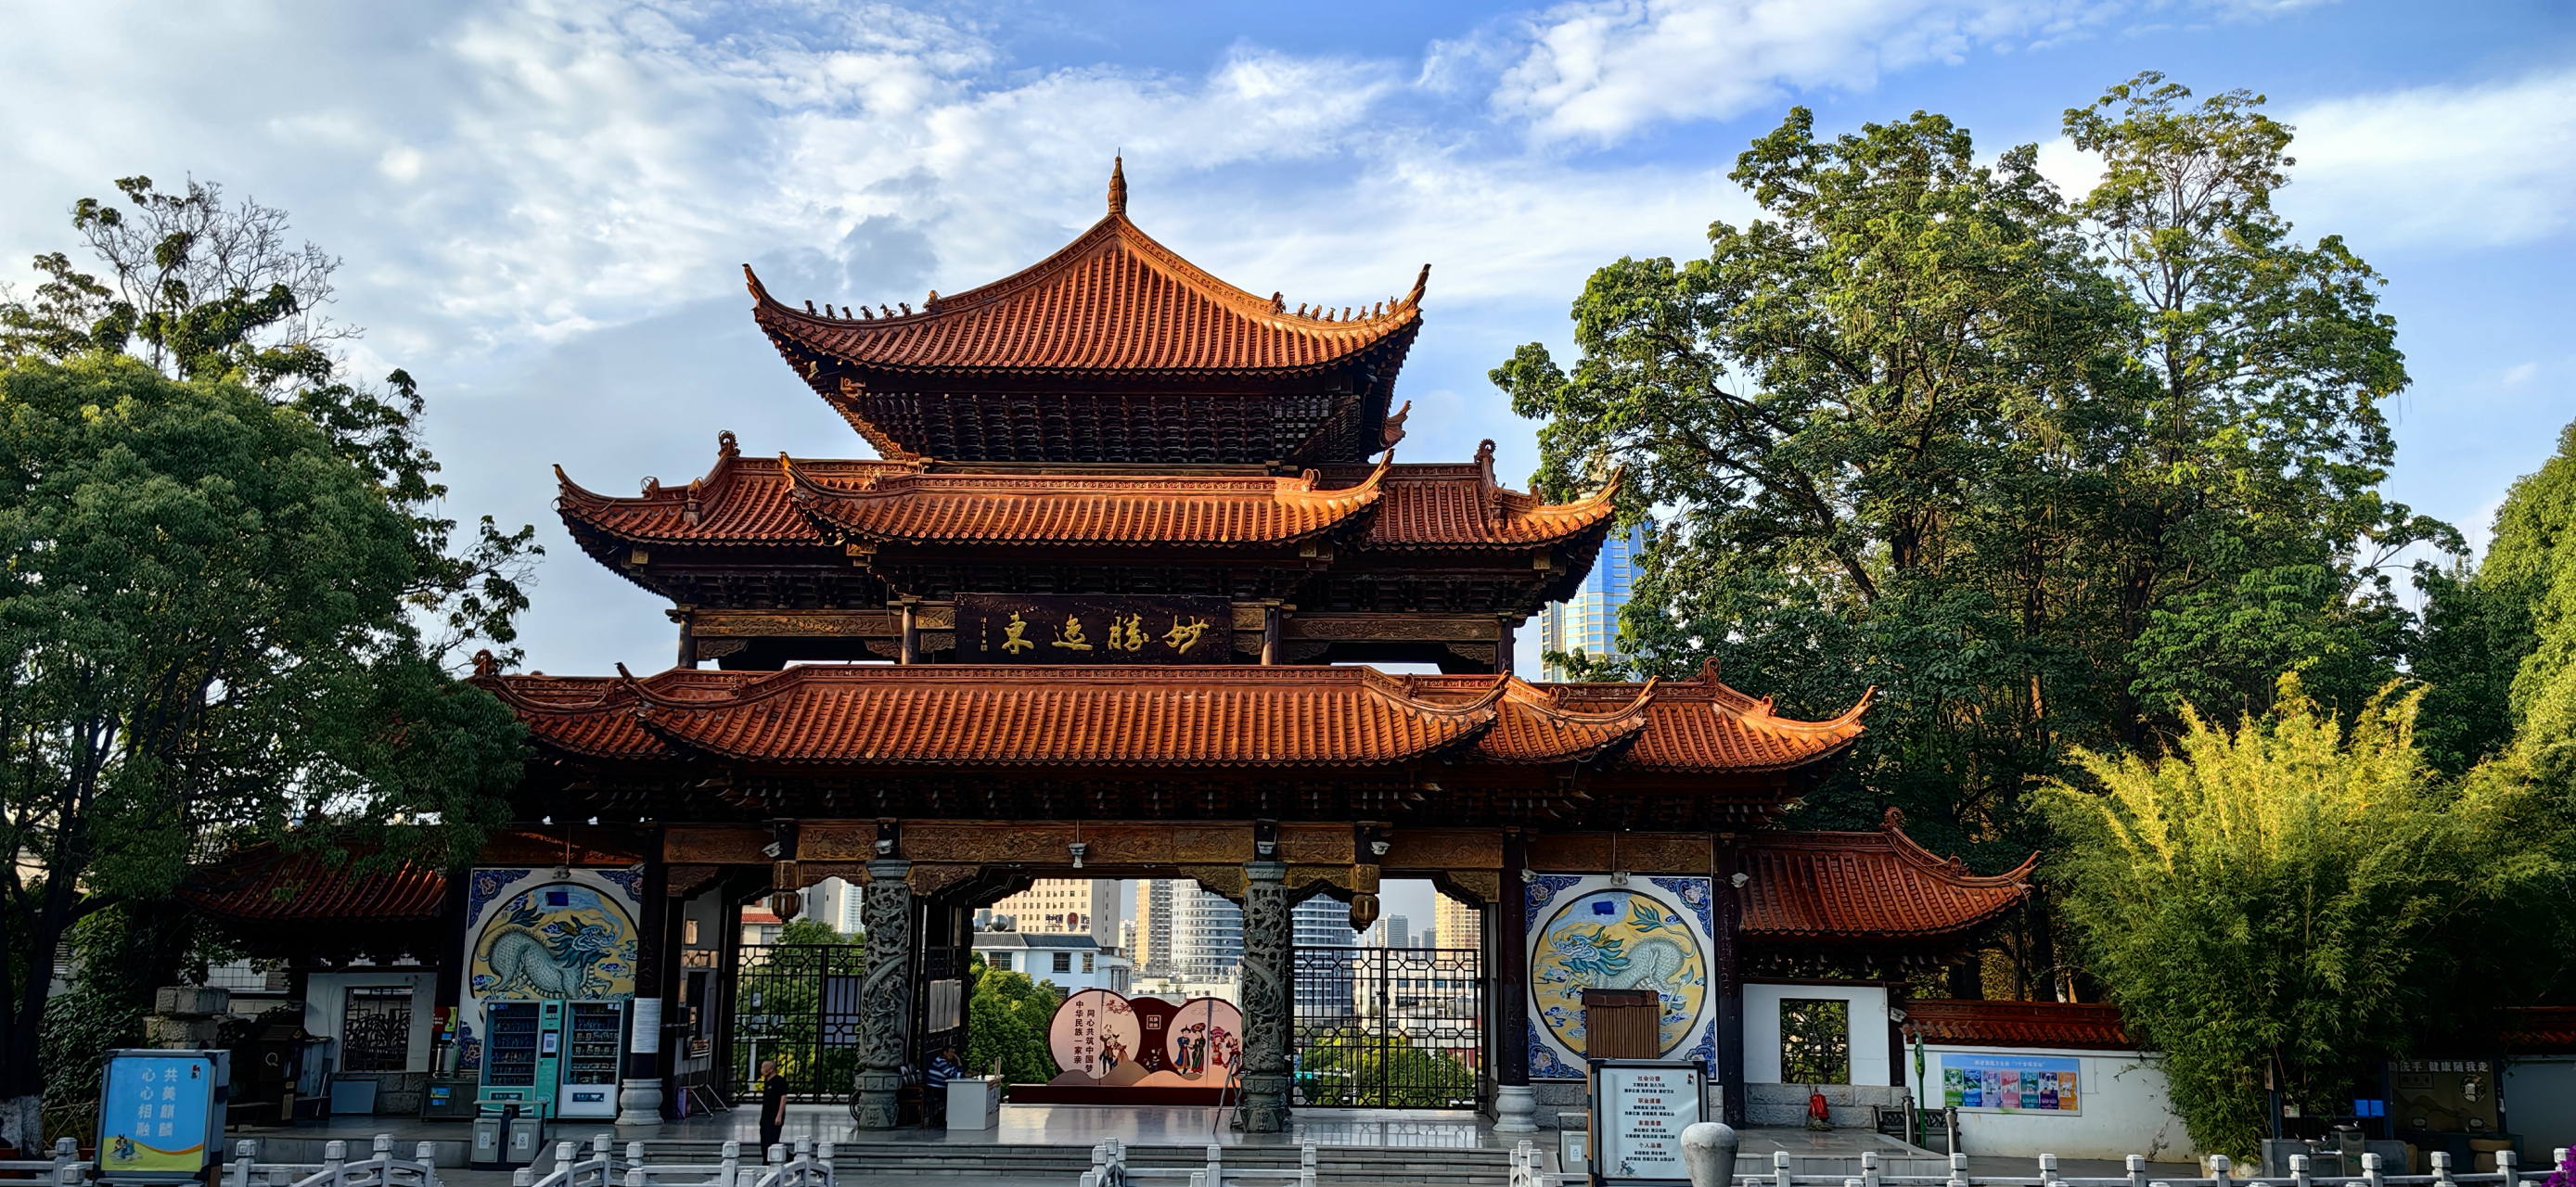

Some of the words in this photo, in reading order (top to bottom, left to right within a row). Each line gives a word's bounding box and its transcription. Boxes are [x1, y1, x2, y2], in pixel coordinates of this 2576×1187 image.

[1073, 1000, 1084, 1065] 中华民族一家亲
[1084, 1009, 1096, 1073] 同心共筑中国梦
[2428, 1061, 2489, 1073] 健康随我走
[135, 1067, 156, 1137] 心心相融
[158, 1066, 178, 1137] 共美麒麟
